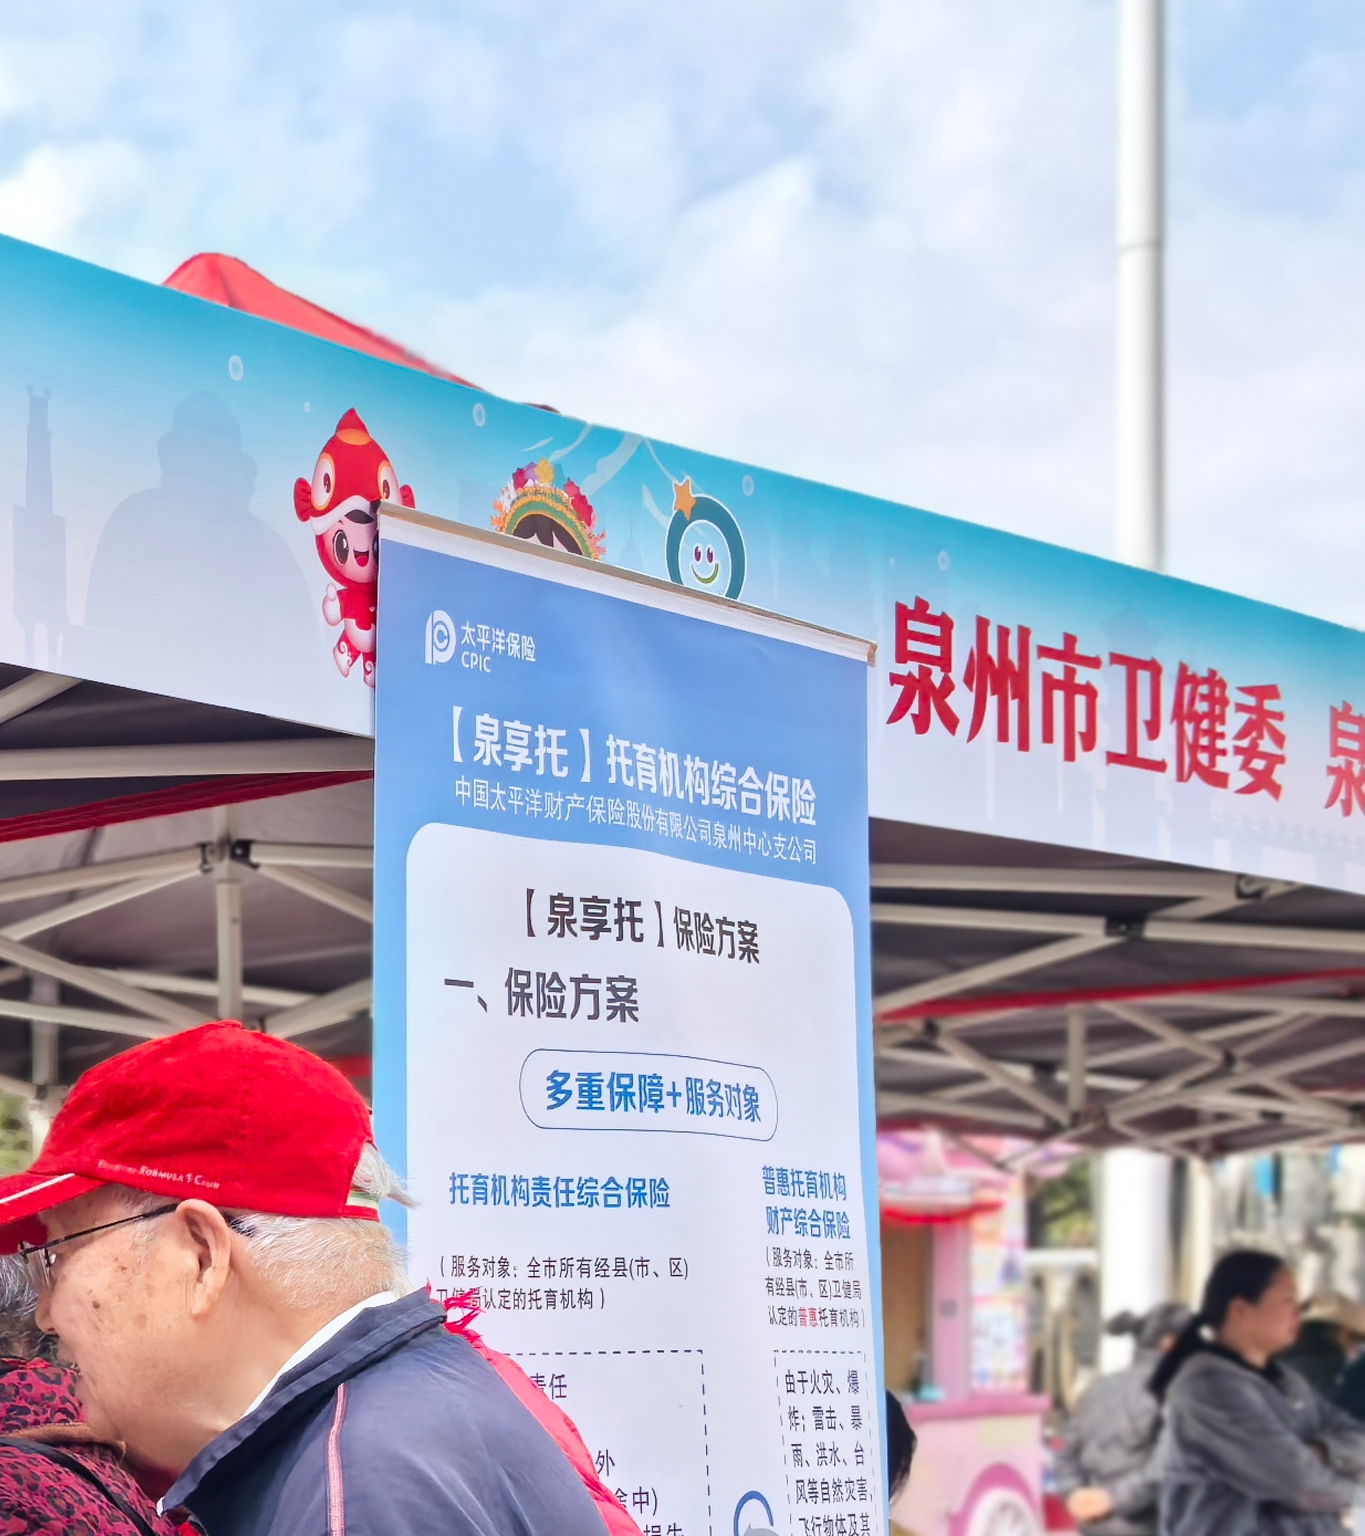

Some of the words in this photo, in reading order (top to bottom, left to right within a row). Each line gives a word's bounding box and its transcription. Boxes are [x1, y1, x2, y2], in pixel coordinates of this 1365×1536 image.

[461, 621, 536, 662] 太平洋保险
[462, 651, 491, 672] CPIC
[885, 595, 1287, 802] 泉州市卫健委
[452, 705, 817, 826] 【泉享托】托育机构综合保险
[455, 775, 817, 865] 中国太平洋财产保险股份有限公司泉州中心支公司
[526, 888, 760, 964] 【泉享托】保险方案
[444, 967, 639, 1022] 一、保险方案
[546, 1070, 761, 1122] 多重保障+服务对象
[449, 1172, 670, 1208] 托育机构责任综合保险
[762, 1165, 847, 1201] 普惠托育机构
[766, 1206, 851, 1239] 财产综合保险
[785, 1370, 859, 1395] 由于火灾、爆
[791, 1441, 864, 1467] 雨、洪水、台
